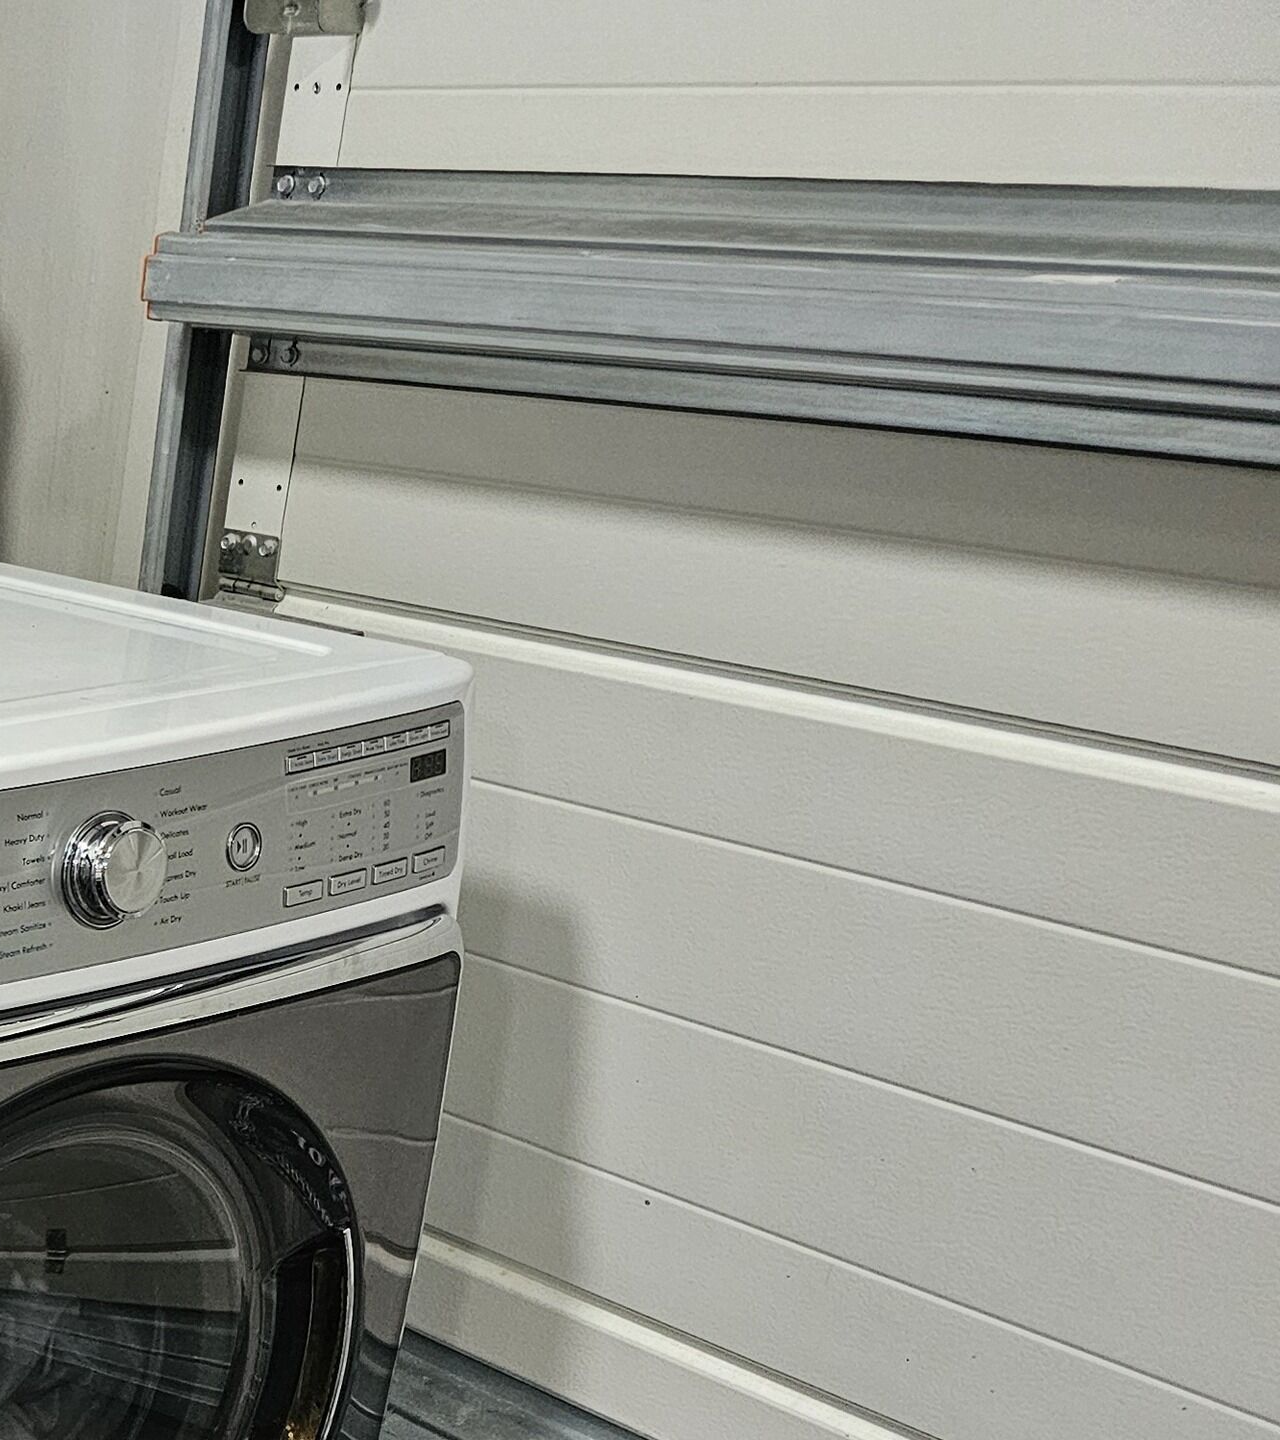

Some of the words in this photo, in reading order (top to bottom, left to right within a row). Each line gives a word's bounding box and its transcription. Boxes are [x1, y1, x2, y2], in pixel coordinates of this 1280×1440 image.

[17, 810, 44, 821] Normal
[4, 837, 27, 847] Heavy
[28, 833, 45, 843] Duty
[178, 848, 193, 859] Load
[184, 869, 197, 879] Dry
[170, 913, 182, 922] Dry
